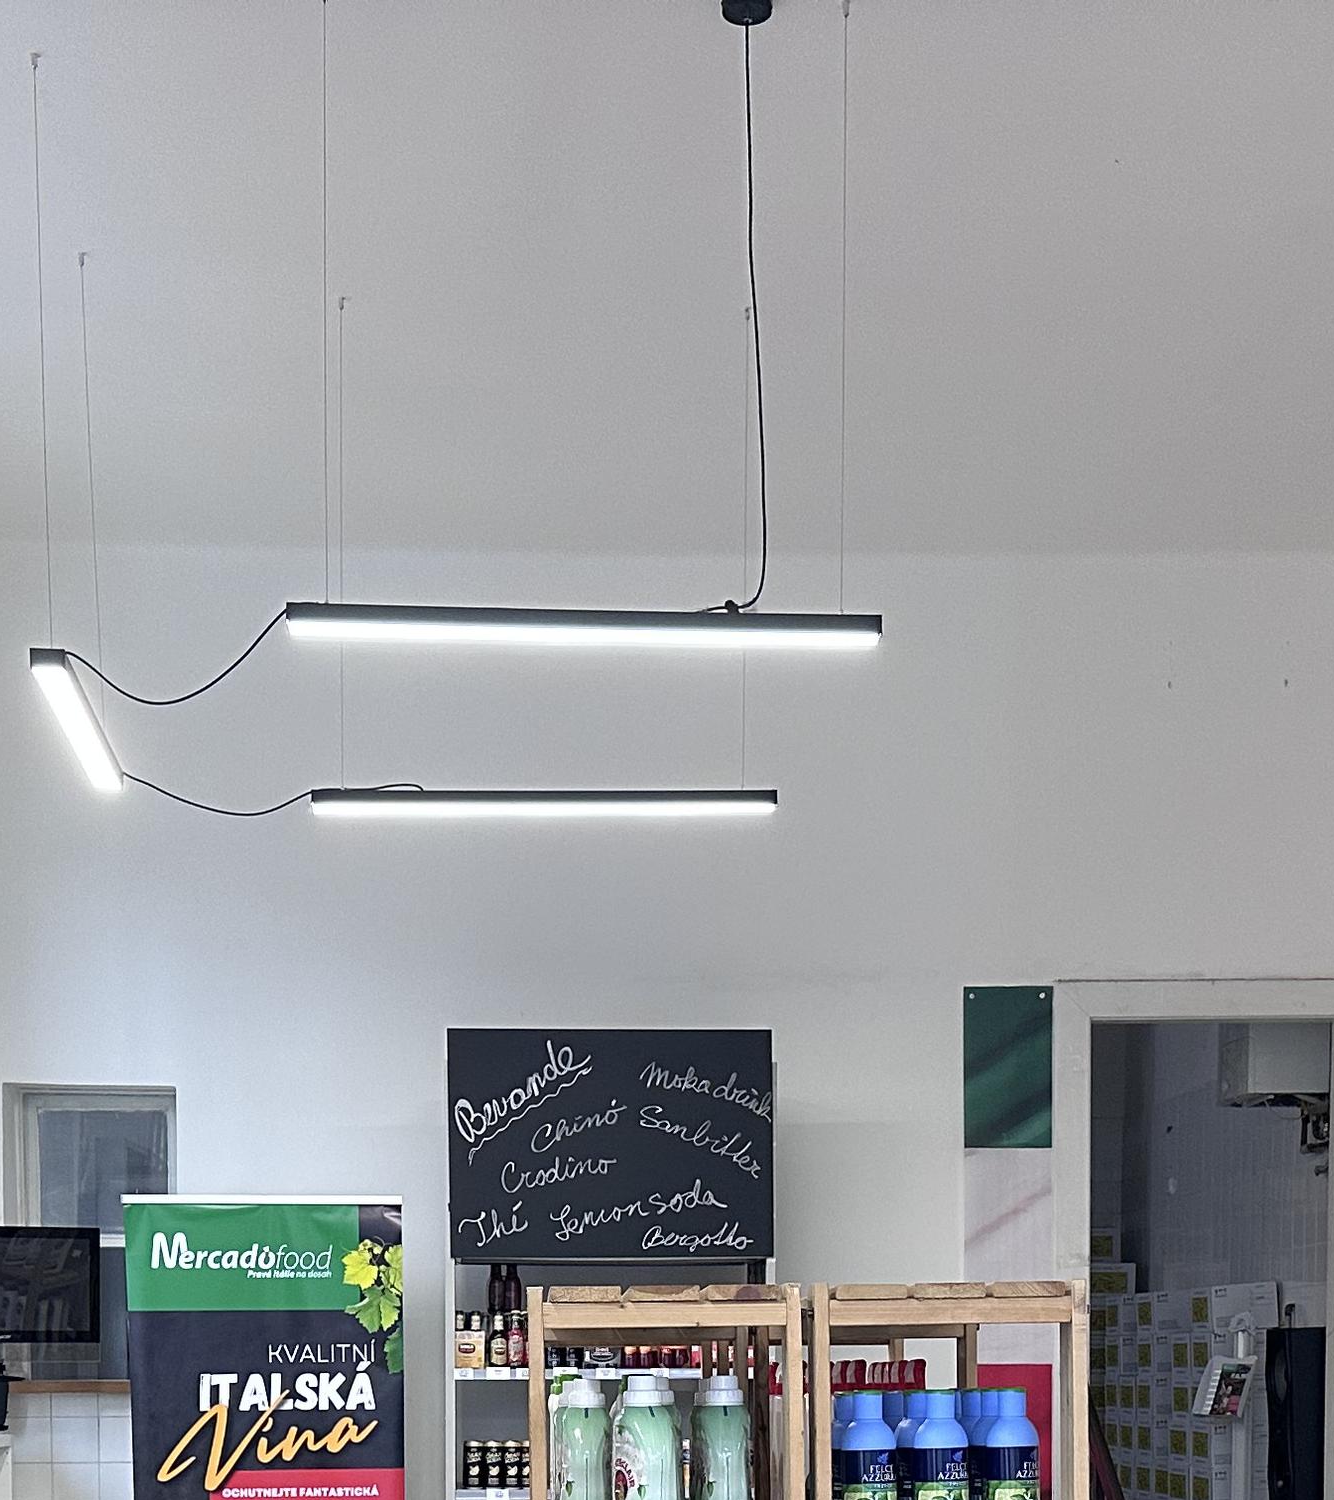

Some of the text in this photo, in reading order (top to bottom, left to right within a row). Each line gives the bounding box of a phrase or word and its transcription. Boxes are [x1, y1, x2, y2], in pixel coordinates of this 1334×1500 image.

[454, 1039, 591, 1143] Bevande
[639, 1105, 762, 1178] Sanbitter
[501, 1156, 617, 1193] Crodino
[268, 1339, 376, 1364] KVALITNÍ
[199, 1361, 376, 1413] ITALSKÁ
[222, 1486, 379, 1498] OCHUTNEJTE FANTASTICKÁ
